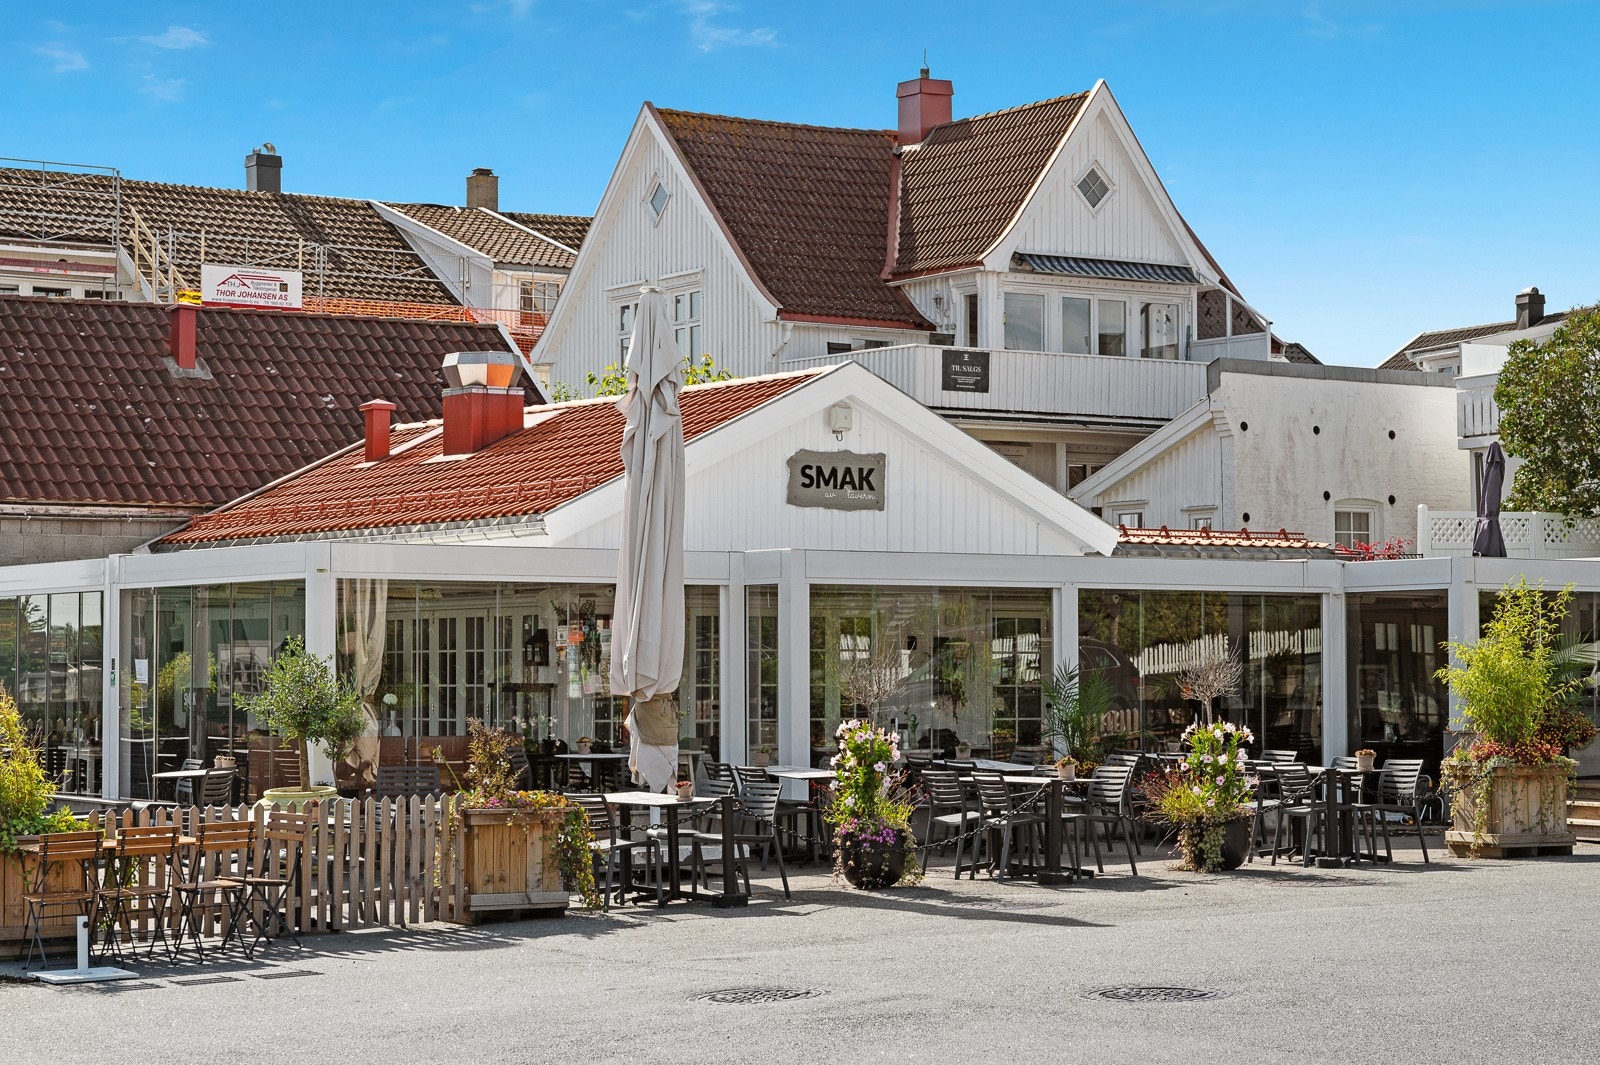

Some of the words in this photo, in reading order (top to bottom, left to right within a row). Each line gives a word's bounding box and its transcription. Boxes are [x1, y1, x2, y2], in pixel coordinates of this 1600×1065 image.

[216, 289, 236, 298] THOR
[238, 291, 277, 300] JOHANSEN
[962, 365, 982, 373] SALGS
[800, 464, 876, 491] SMAK
